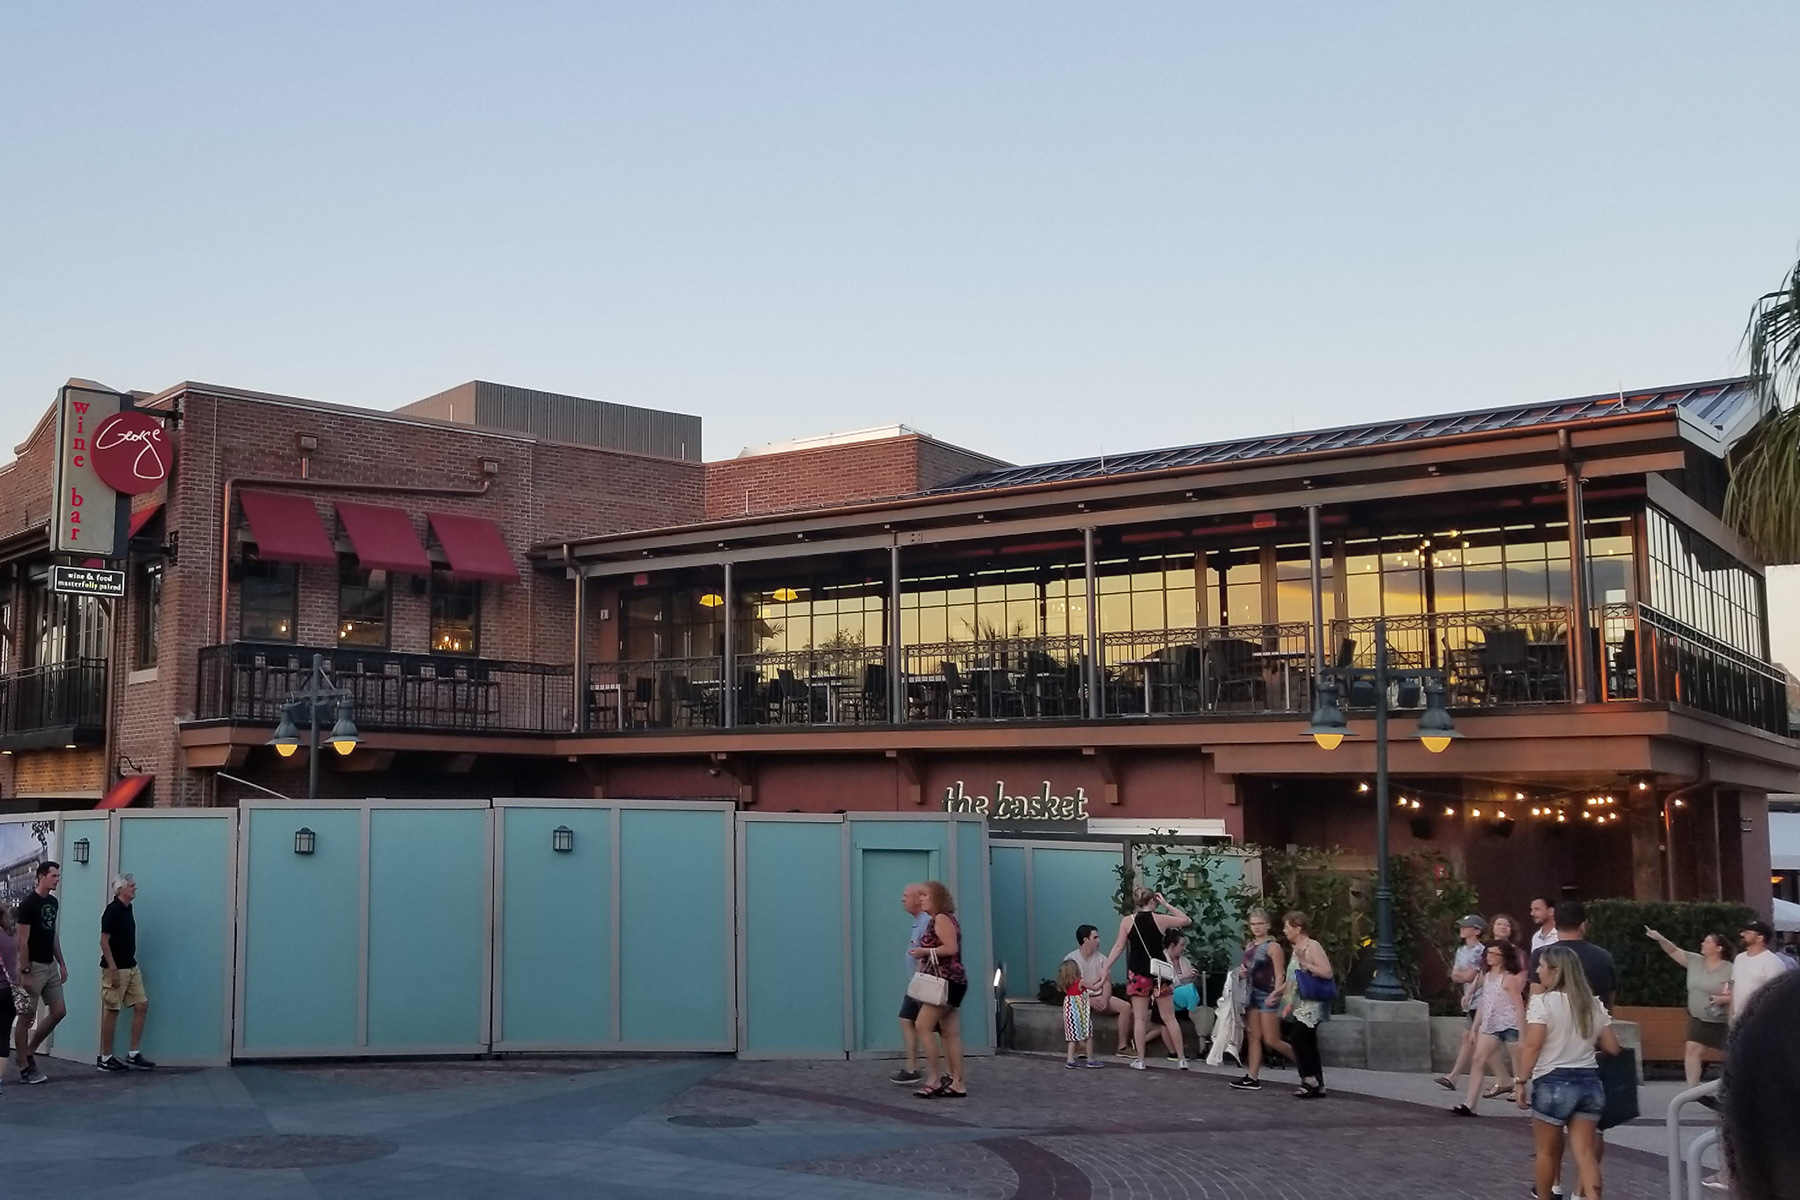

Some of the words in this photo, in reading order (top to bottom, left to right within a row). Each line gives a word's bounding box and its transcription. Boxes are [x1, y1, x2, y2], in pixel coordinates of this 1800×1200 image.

[72, 401, 90, 467] wine
[96, 418, 164, 479] George
[70, 487, 84, 540] bar
[57, 580, 98, 590] masterfully
[99, 583, 121, 591] paired
[67, 572, 85, 580] wine
[86, 572, 95, 581] &
[96, 573, 113, 582] food
[942, 780, 989, 816] the
[993, 780, 1089, 821] basket
